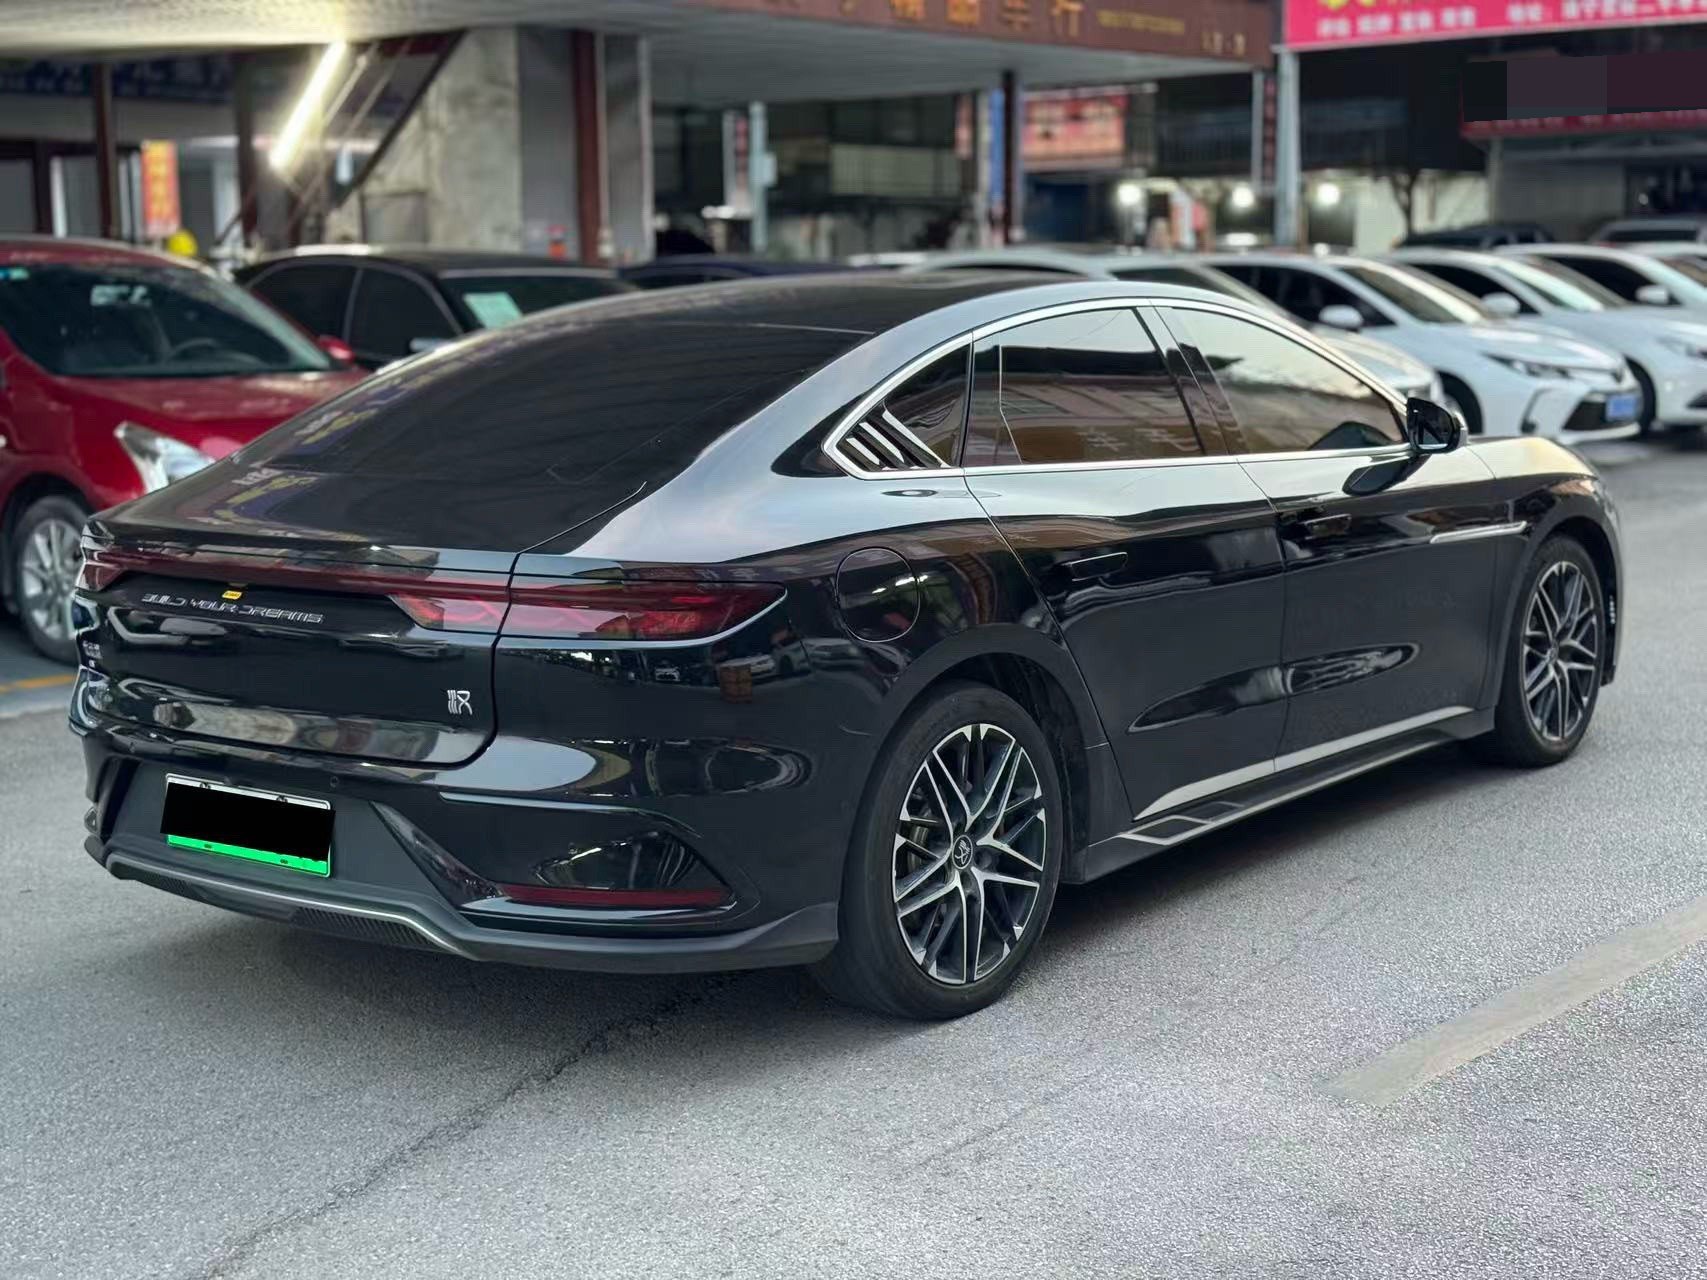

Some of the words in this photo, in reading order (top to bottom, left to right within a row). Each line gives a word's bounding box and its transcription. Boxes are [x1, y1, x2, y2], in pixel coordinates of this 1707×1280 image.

[141, 593, 187, 607] BUILD
[191, 598, 239, 614] YOUR
[239, 604, 325, 624] DREAMS
